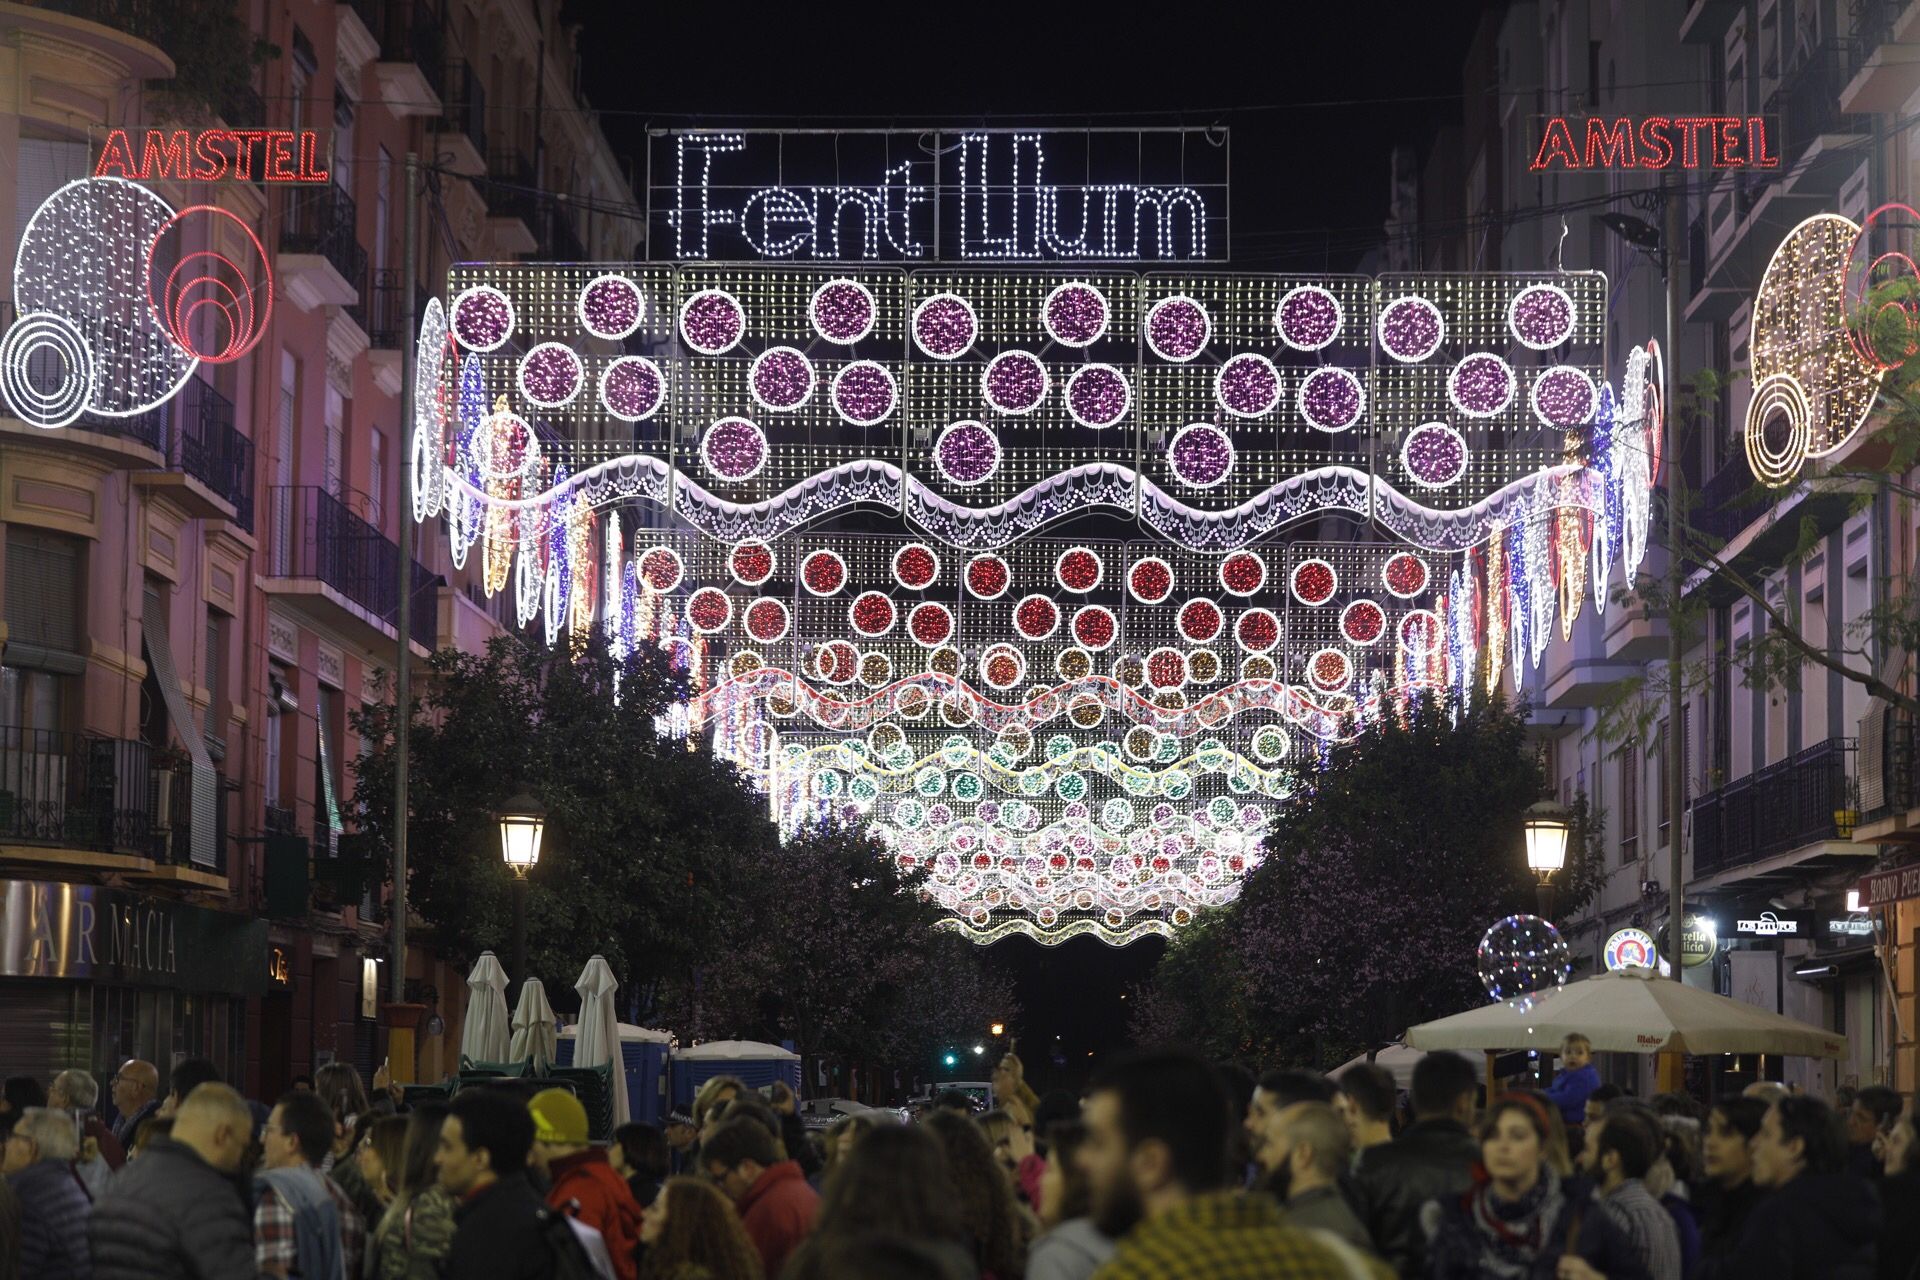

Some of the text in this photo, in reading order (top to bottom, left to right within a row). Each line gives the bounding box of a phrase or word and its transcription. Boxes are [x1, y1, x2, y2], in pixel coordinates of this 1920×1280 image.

[95, 129, 329, 182] AMSTEL
[1530, 117, 1779, 171] AMSTEL
[668, 134, 1207, 258] Fent Llum
[1869, 875, 1898, 903] HORNO
[24, 900, 176, 973] ARMACIA
[1681, 931, 1706, 941] rella
[1682, 941, 1704, 952] licia
